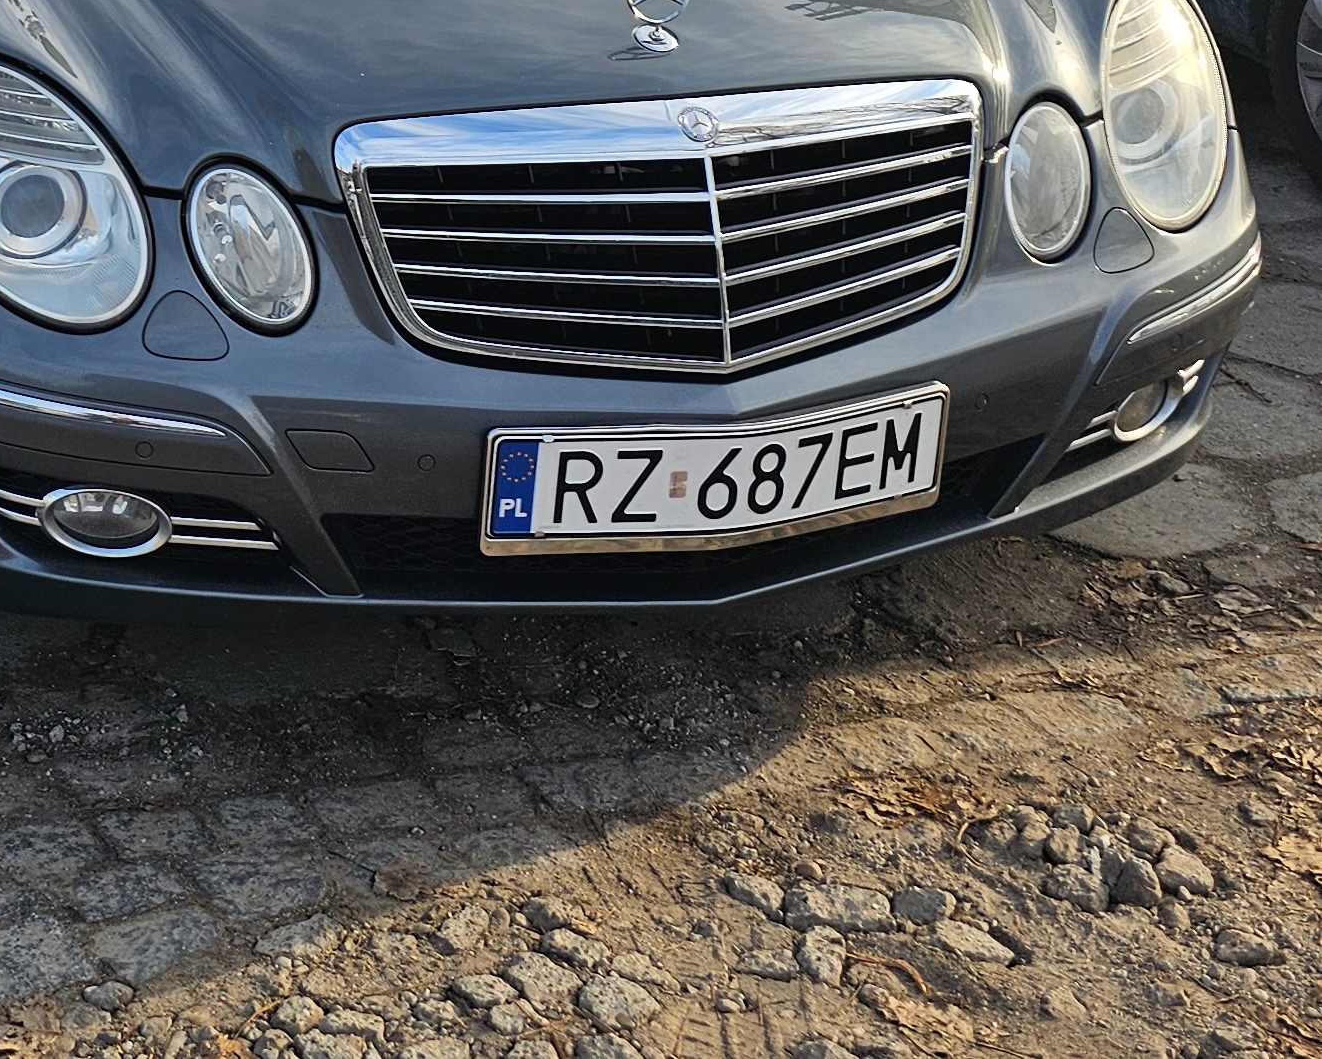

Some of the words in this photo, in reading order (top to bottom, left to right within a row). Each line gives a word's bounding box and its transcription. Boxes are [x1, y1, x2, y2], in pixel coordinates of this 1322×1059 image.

[552, 449, 664, 524] RZ
[696, 411, 922, 520] 687EM
[498, 498, 528, 519] PL
